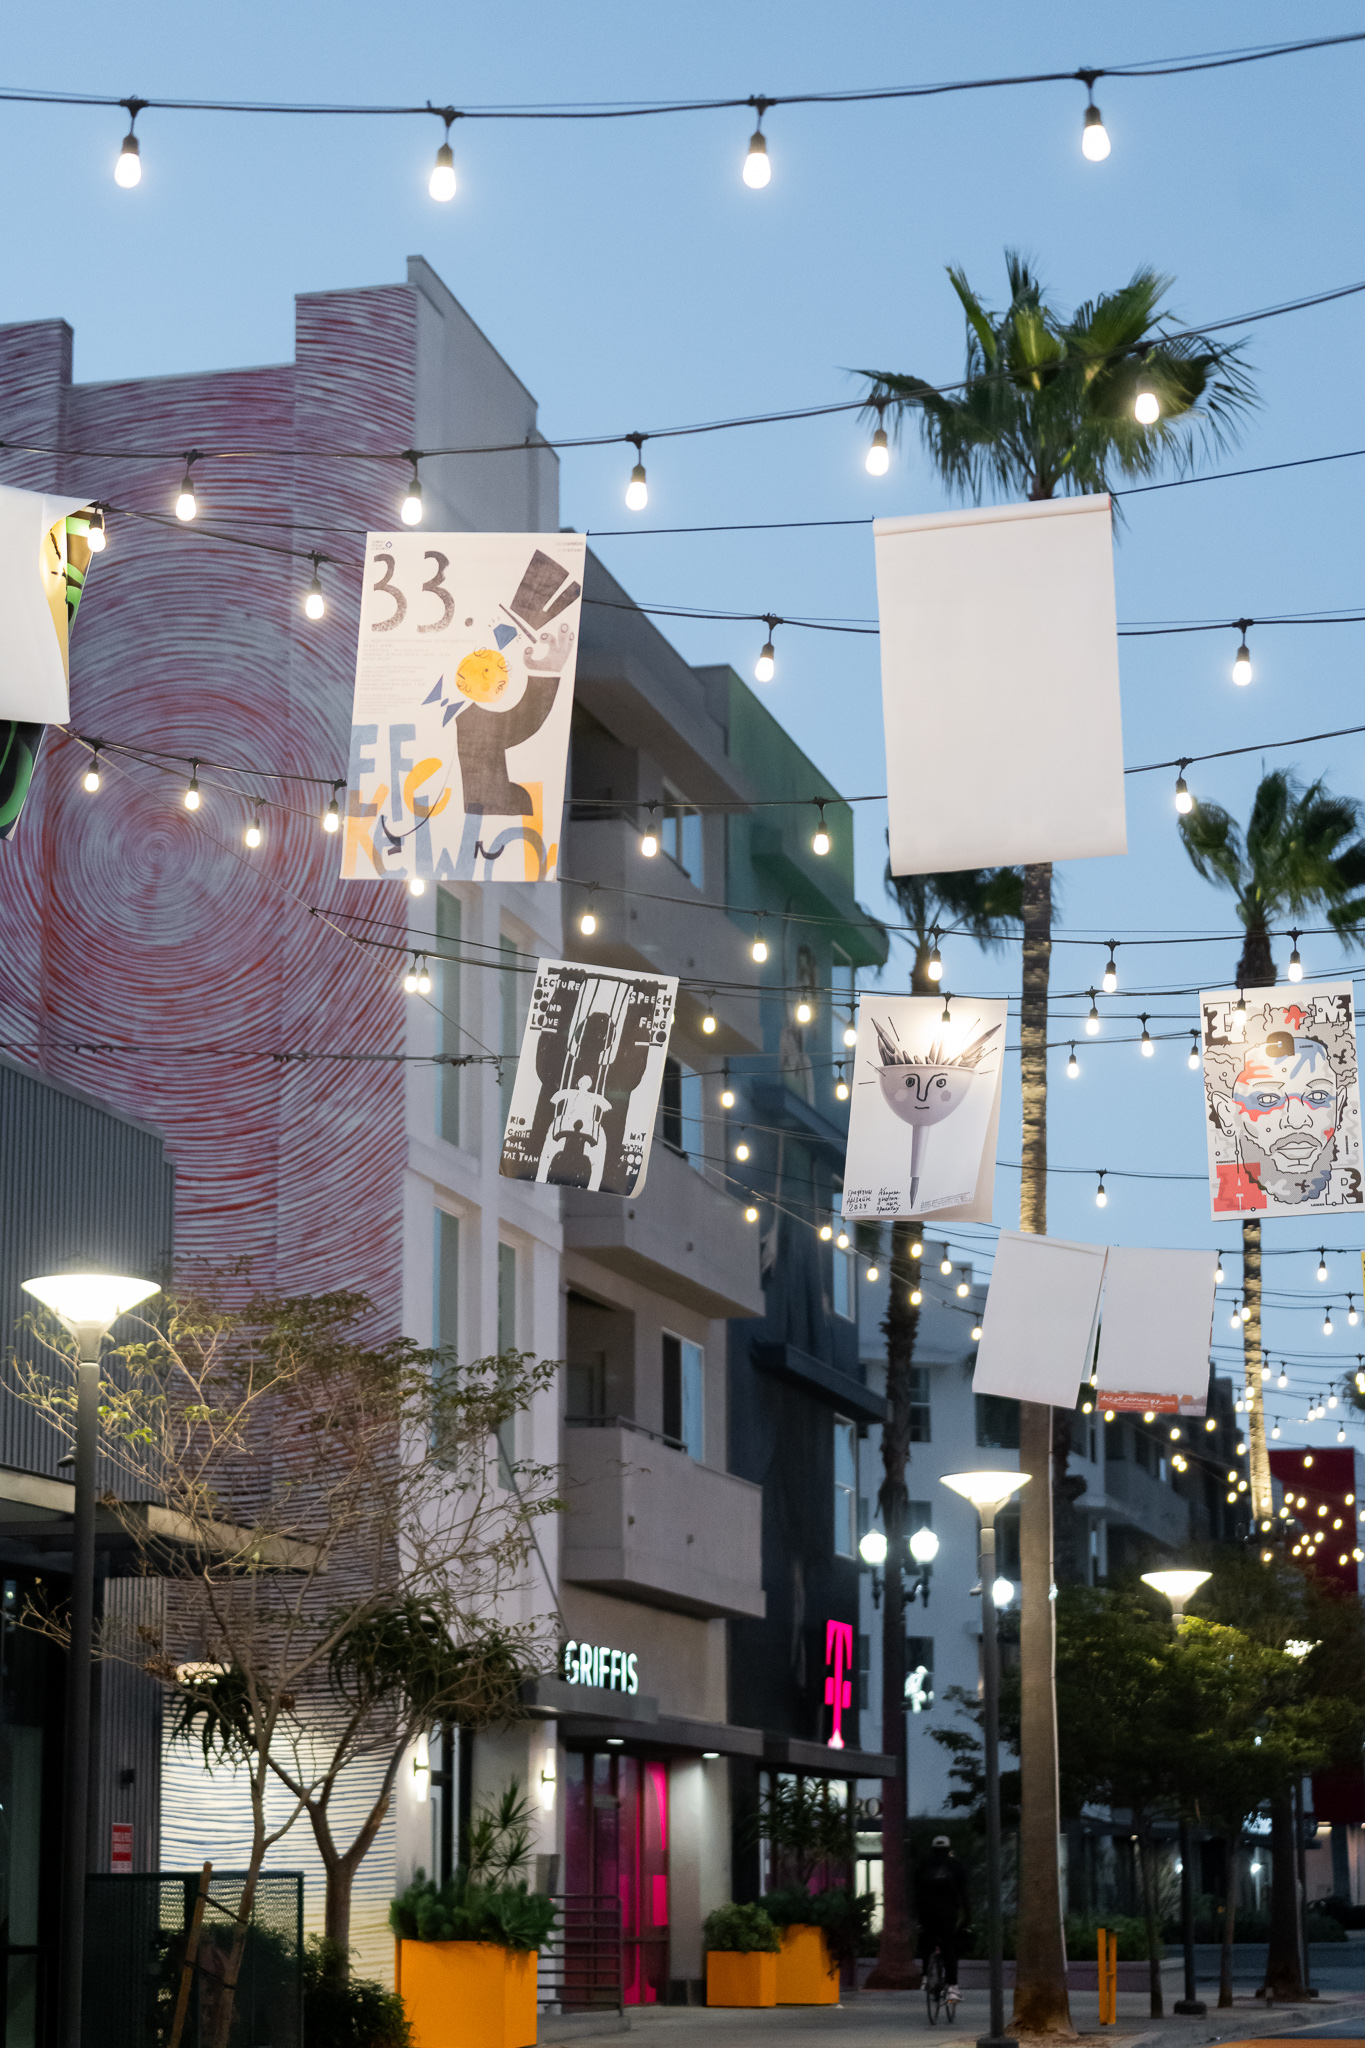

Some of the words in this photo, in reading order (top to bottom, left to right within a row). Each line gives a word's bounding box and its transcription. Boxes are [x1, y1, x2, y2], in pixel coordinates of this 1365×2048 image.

[537, 976, 580, 990] LECTURE
[534, 988, 549, 1000] ON
[629, 991, 672, 1006] SPEECH
[533, 1000, 561, 1012] BOND
[655, 1007, 670, 1018] BY
[532, 1013, 558, 1026] LOVE
[639, 1016, 666, 1029] FENG
[649, 1030, 666, 1043] YO
[630, 1132, 646, 1141] MAY
[503, 1151, 516, 1160] TAI
[519, 1152, 539, 1162] YUAN
[620, 1154, 642, 1165] 4:00
[626, 1165, 639, 1176] PM
[564, 1640, 639, 1695] GRIFFIS
